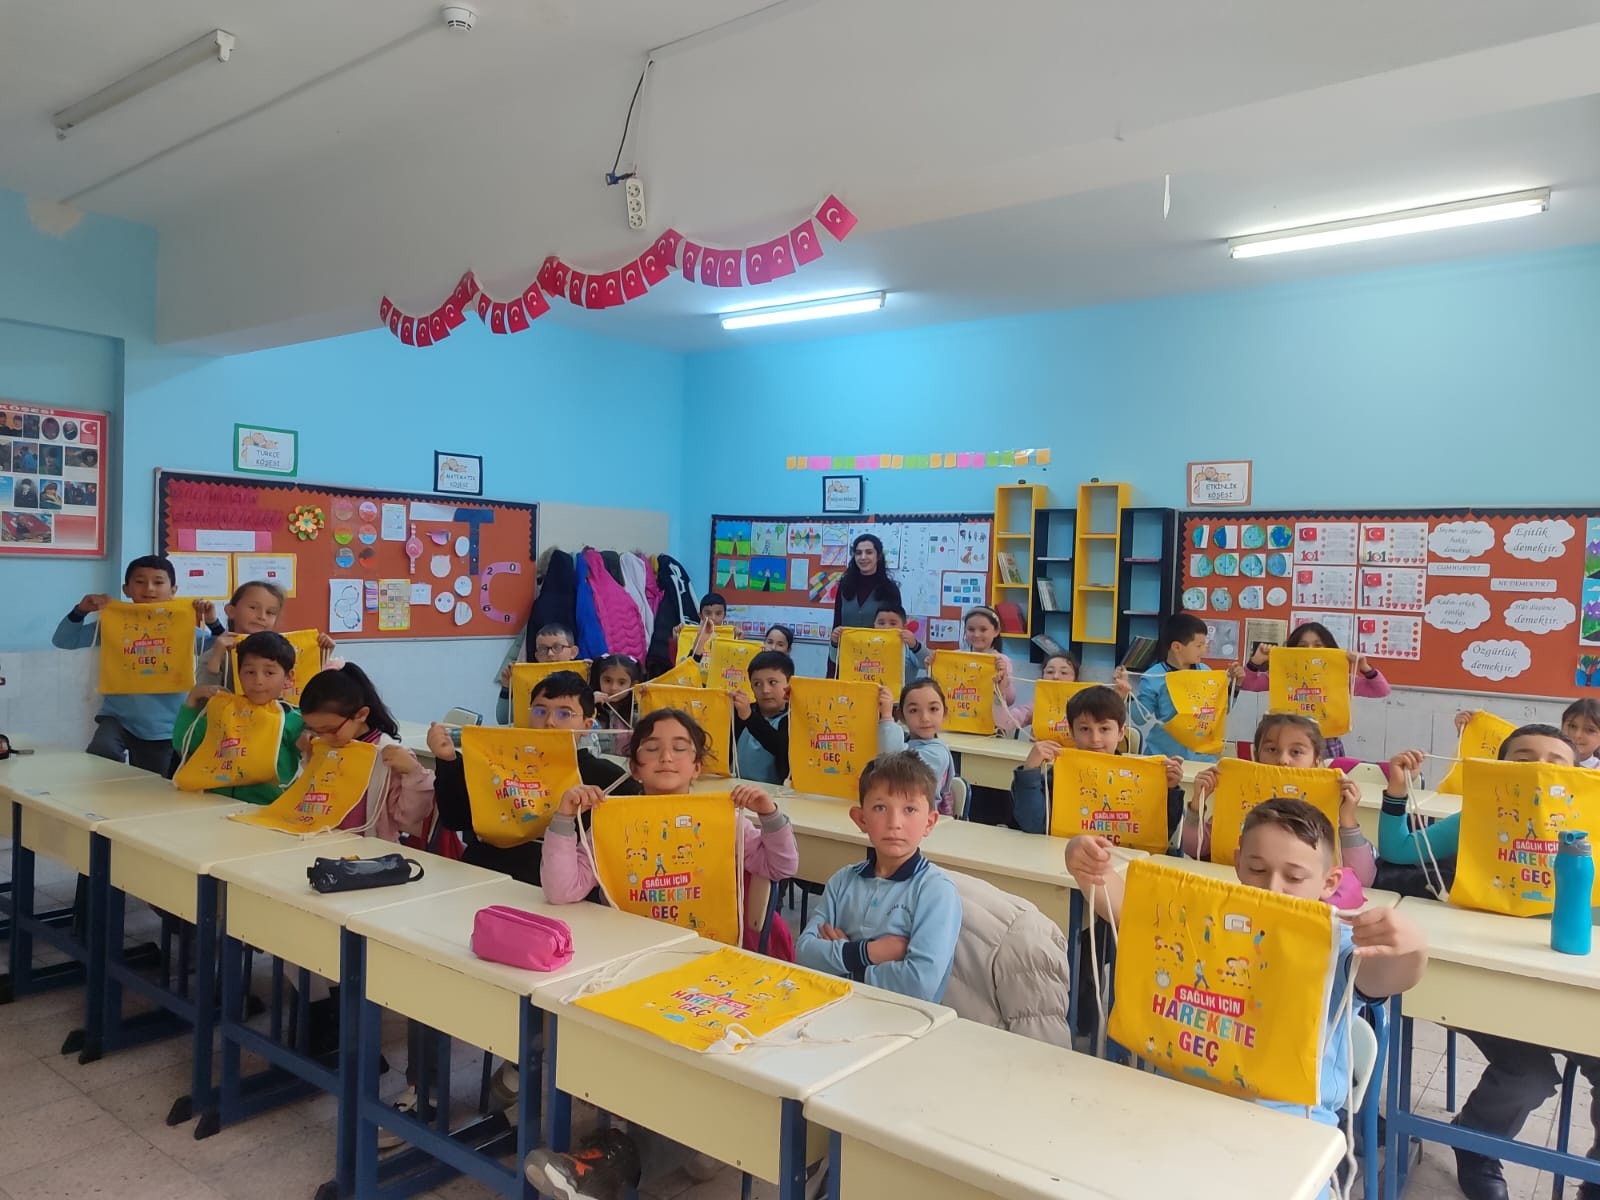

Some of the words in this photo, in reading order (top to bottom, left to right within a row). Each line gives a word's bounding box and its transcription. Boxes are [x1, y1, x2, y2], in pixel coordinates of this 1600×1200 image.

[1206, 482, 1237, 490] ETKİNLİK
[1207, 491, 1233, 500] KÖŞESİ
[1514, 527, 1550, 538] Eşitlik
[1513, 542, 1558, 553] demektir.
[1514, 614, 1559, 626] demektir.
[1472, 645, 1518, 658] Özgürlük
[138, 656, 157, 667] GEÇ
[1470, 660, 1514, 673] demektir.
[823, 752, 841, 765] GEÇ
[495, 785, 551, 801] HAREKETE
[513, 798, 536, 810] GEÇ
[1081, 819, 1139, 834] HAREKETE
[1515, 840, 1543, 852] SAĞLIK
[1498, 848, 1556, 868] HAREKE
[645, 876, 672, 888] SAĞLIK
[673, 874, 689, 887] İÇİN
[1521, 867, 1552, 888] GEÇ
[629, 887, 702, 902] HAREKETE
[651, 905, 679, 922] GEÇ
[670, 990, 750, 1020] HAREKETE
[1179, 987, 1217, 1009] SAĞLIK
[1218, 996, 1242, 1015] İÇİN
[678, 1003, 712, 1018] GEÇ
[1152, 994, 1257, 1049] HAREKETE
[1178, 1030, 1220, 1067] GEÇ
